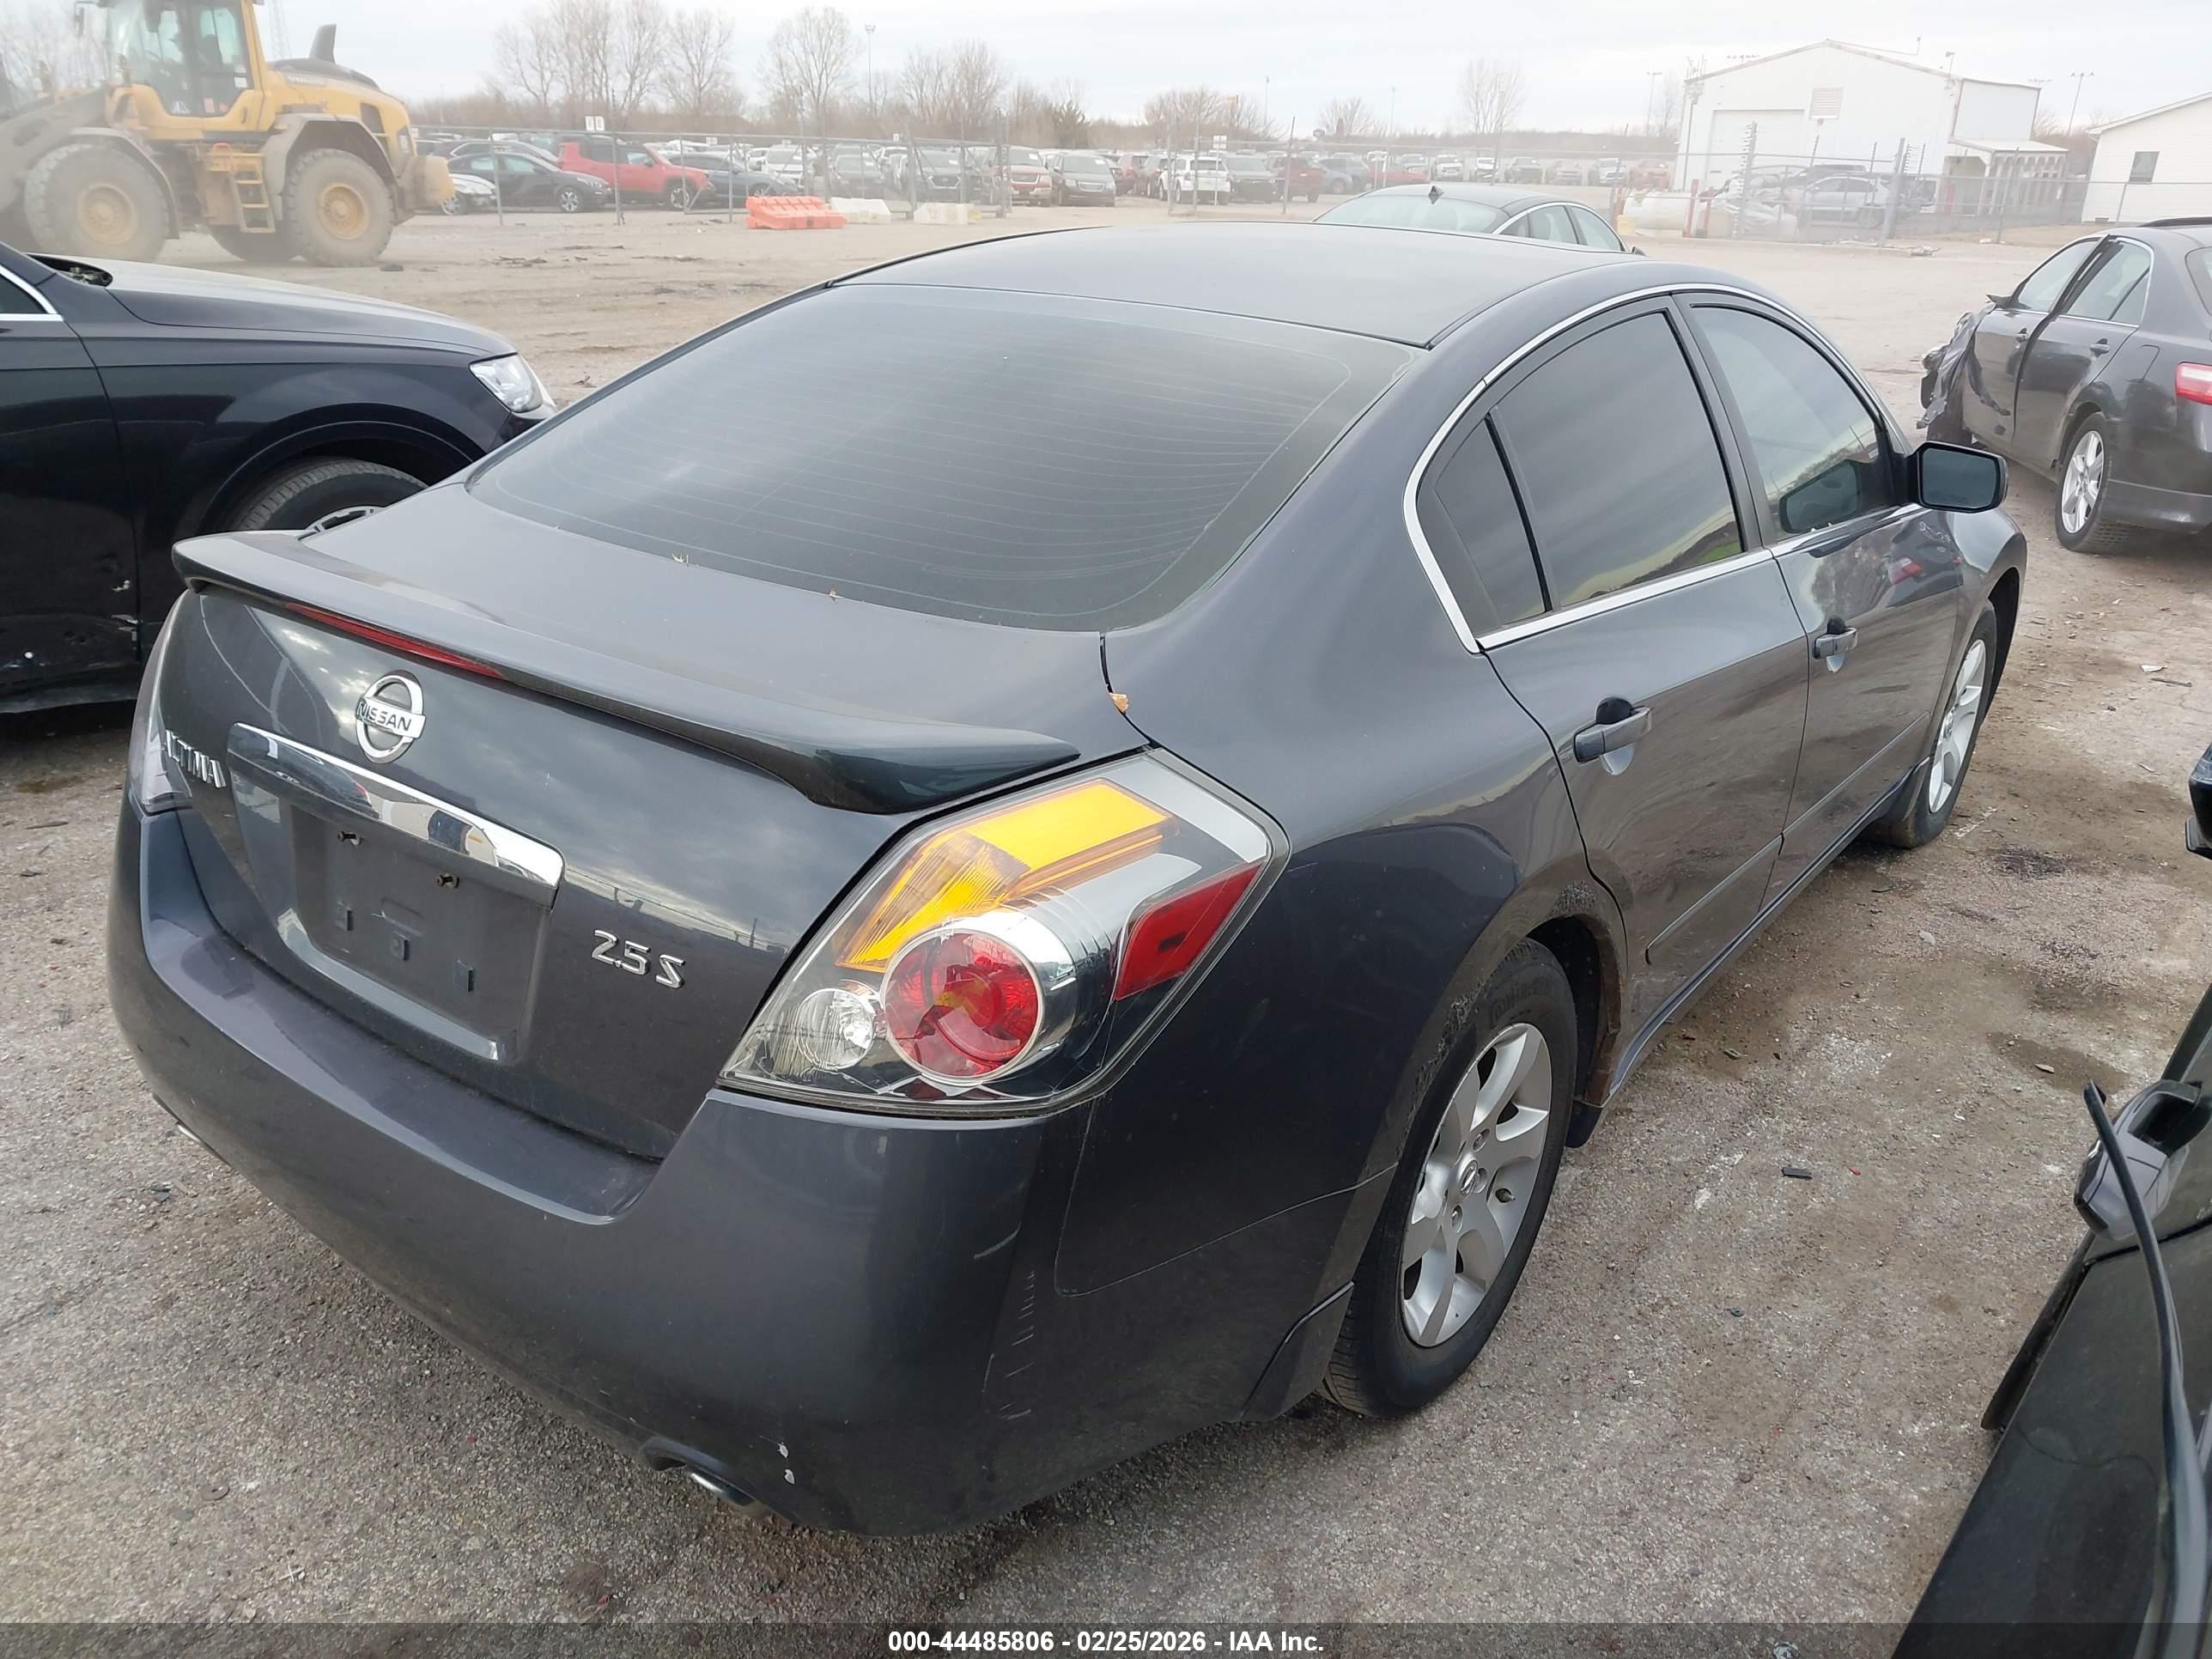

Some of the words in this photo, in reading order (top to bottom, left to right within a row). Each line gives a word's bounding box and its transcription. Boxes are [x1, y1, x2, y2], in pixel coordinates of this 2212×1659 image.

[357, 702, 411, 732] NISSAN
[592, 929, 649, 975] 2.5
[656, 954, 684, 988] S
